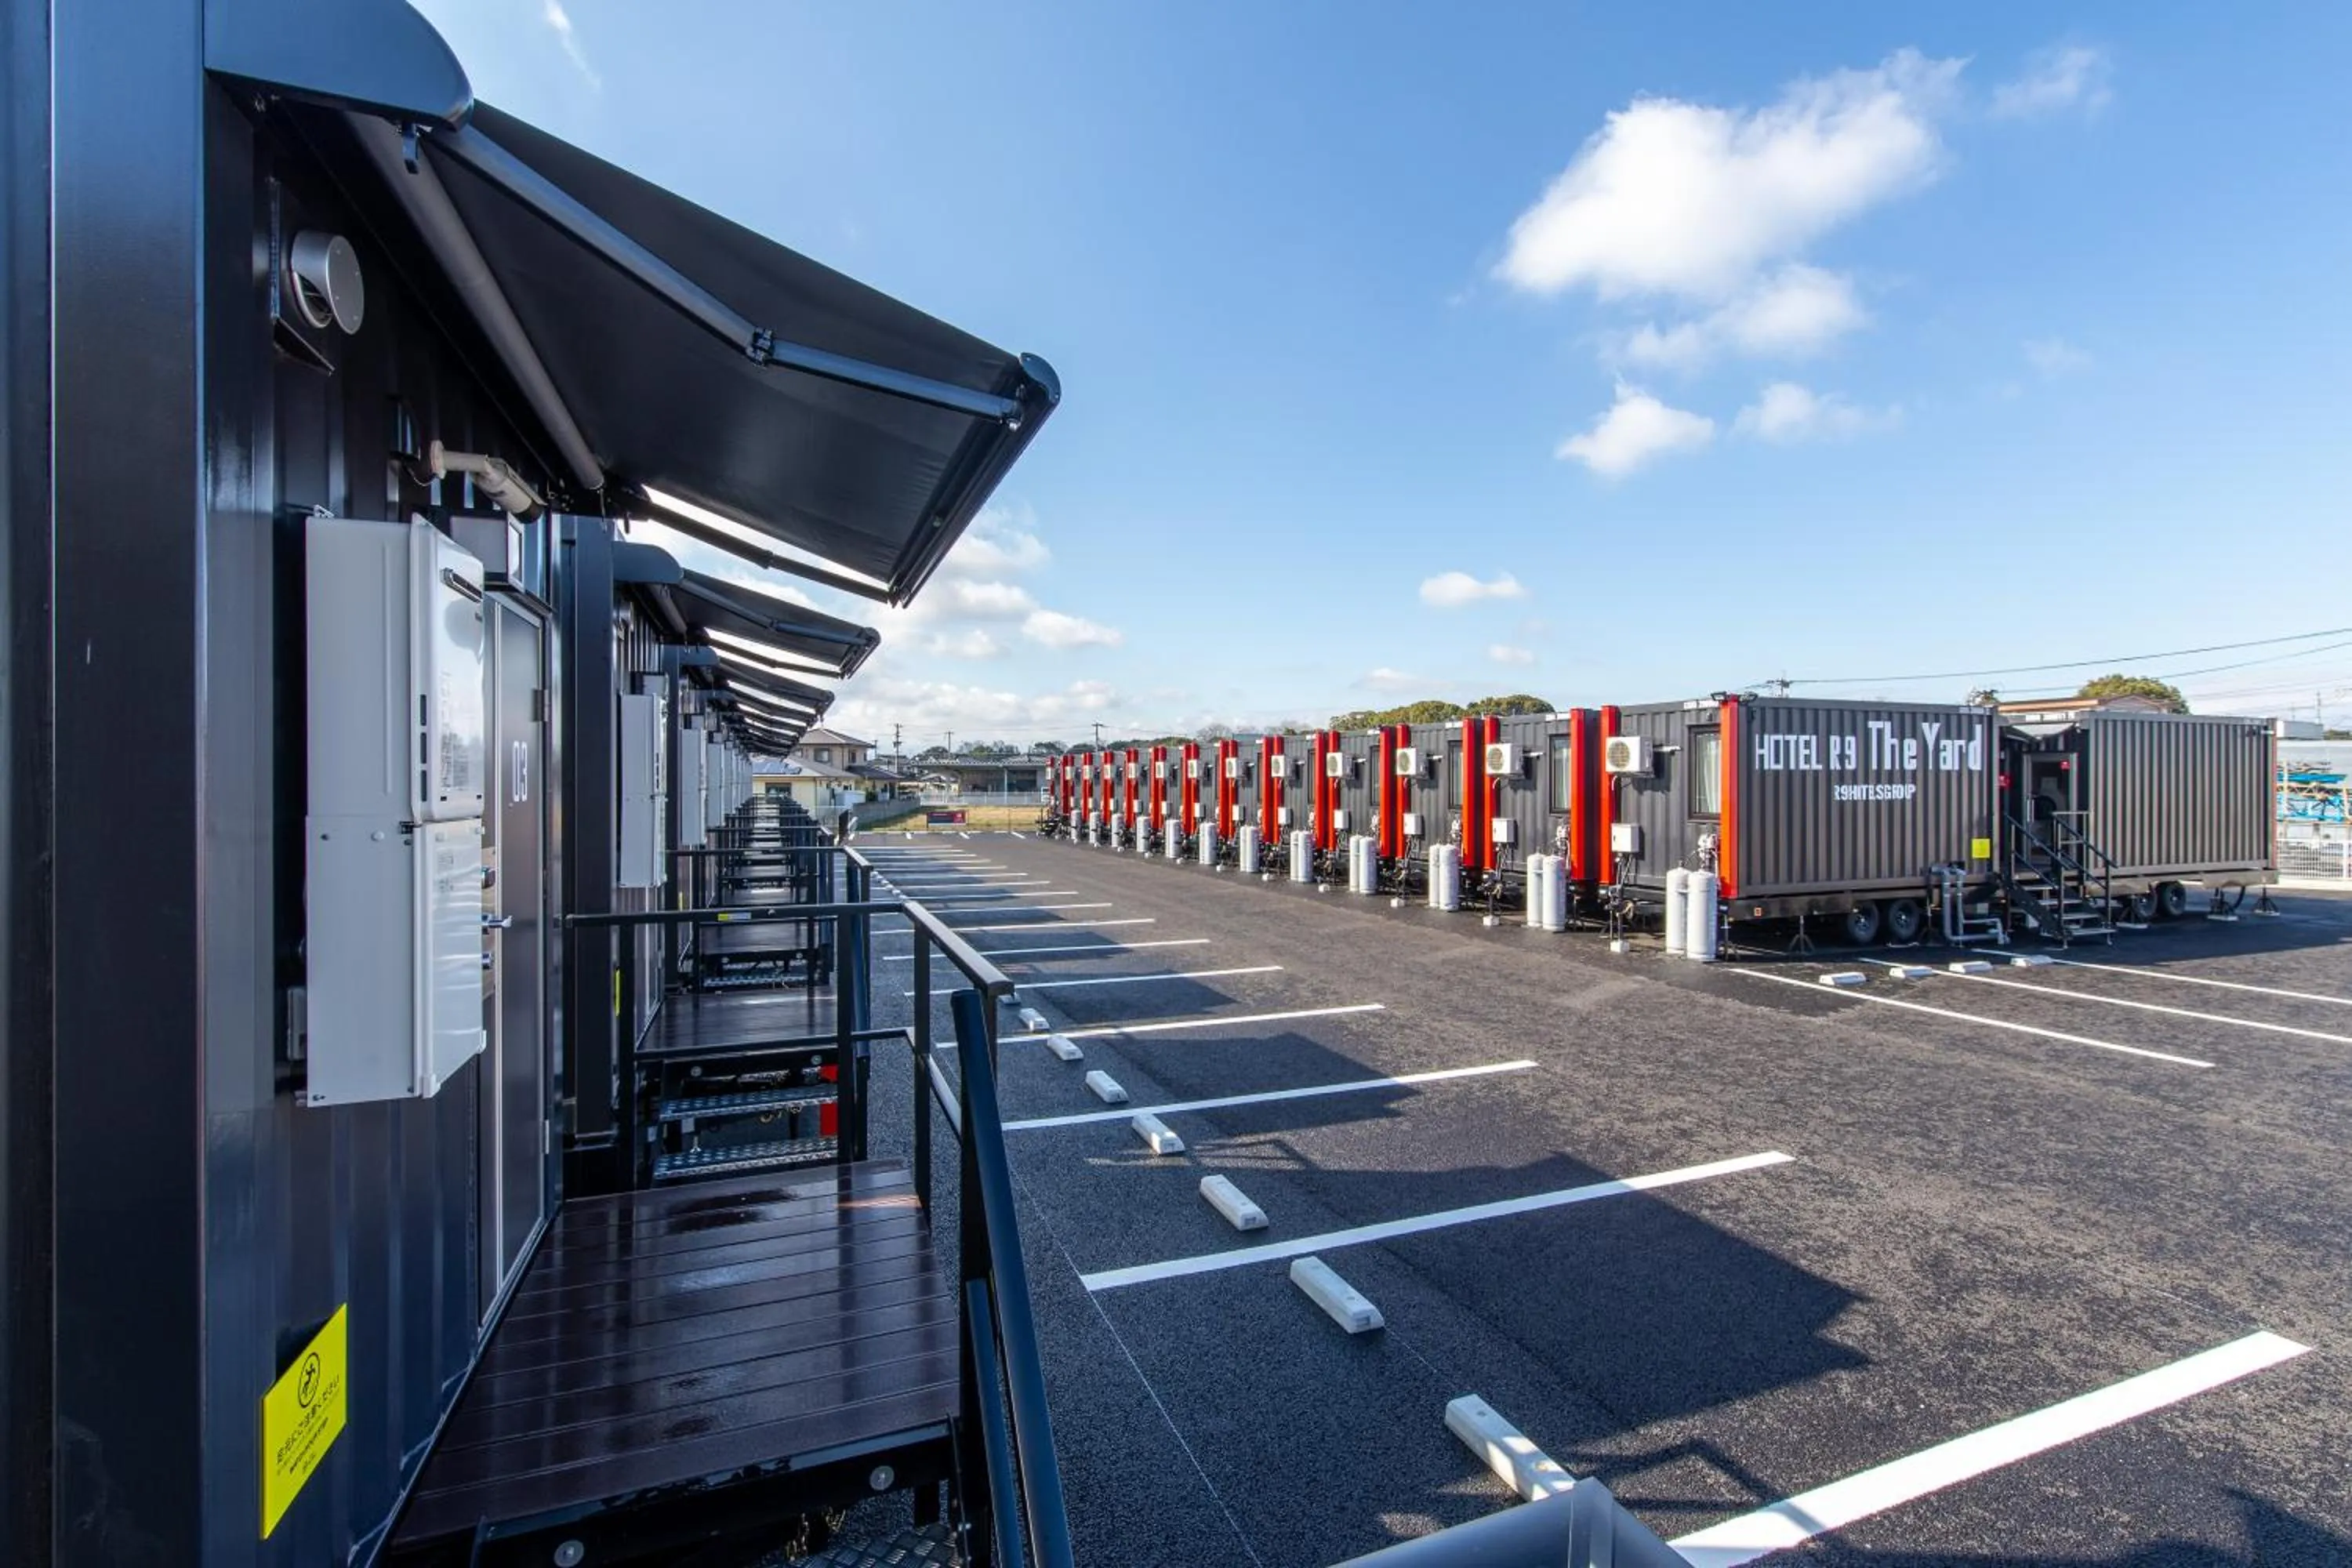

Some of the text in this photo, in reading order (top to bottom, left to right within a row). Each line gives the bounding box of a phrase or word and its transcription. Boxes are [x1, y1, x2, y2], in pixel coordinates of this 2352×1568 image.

[1755, 720, 1983, 771] HOTEL R9 The Yard
